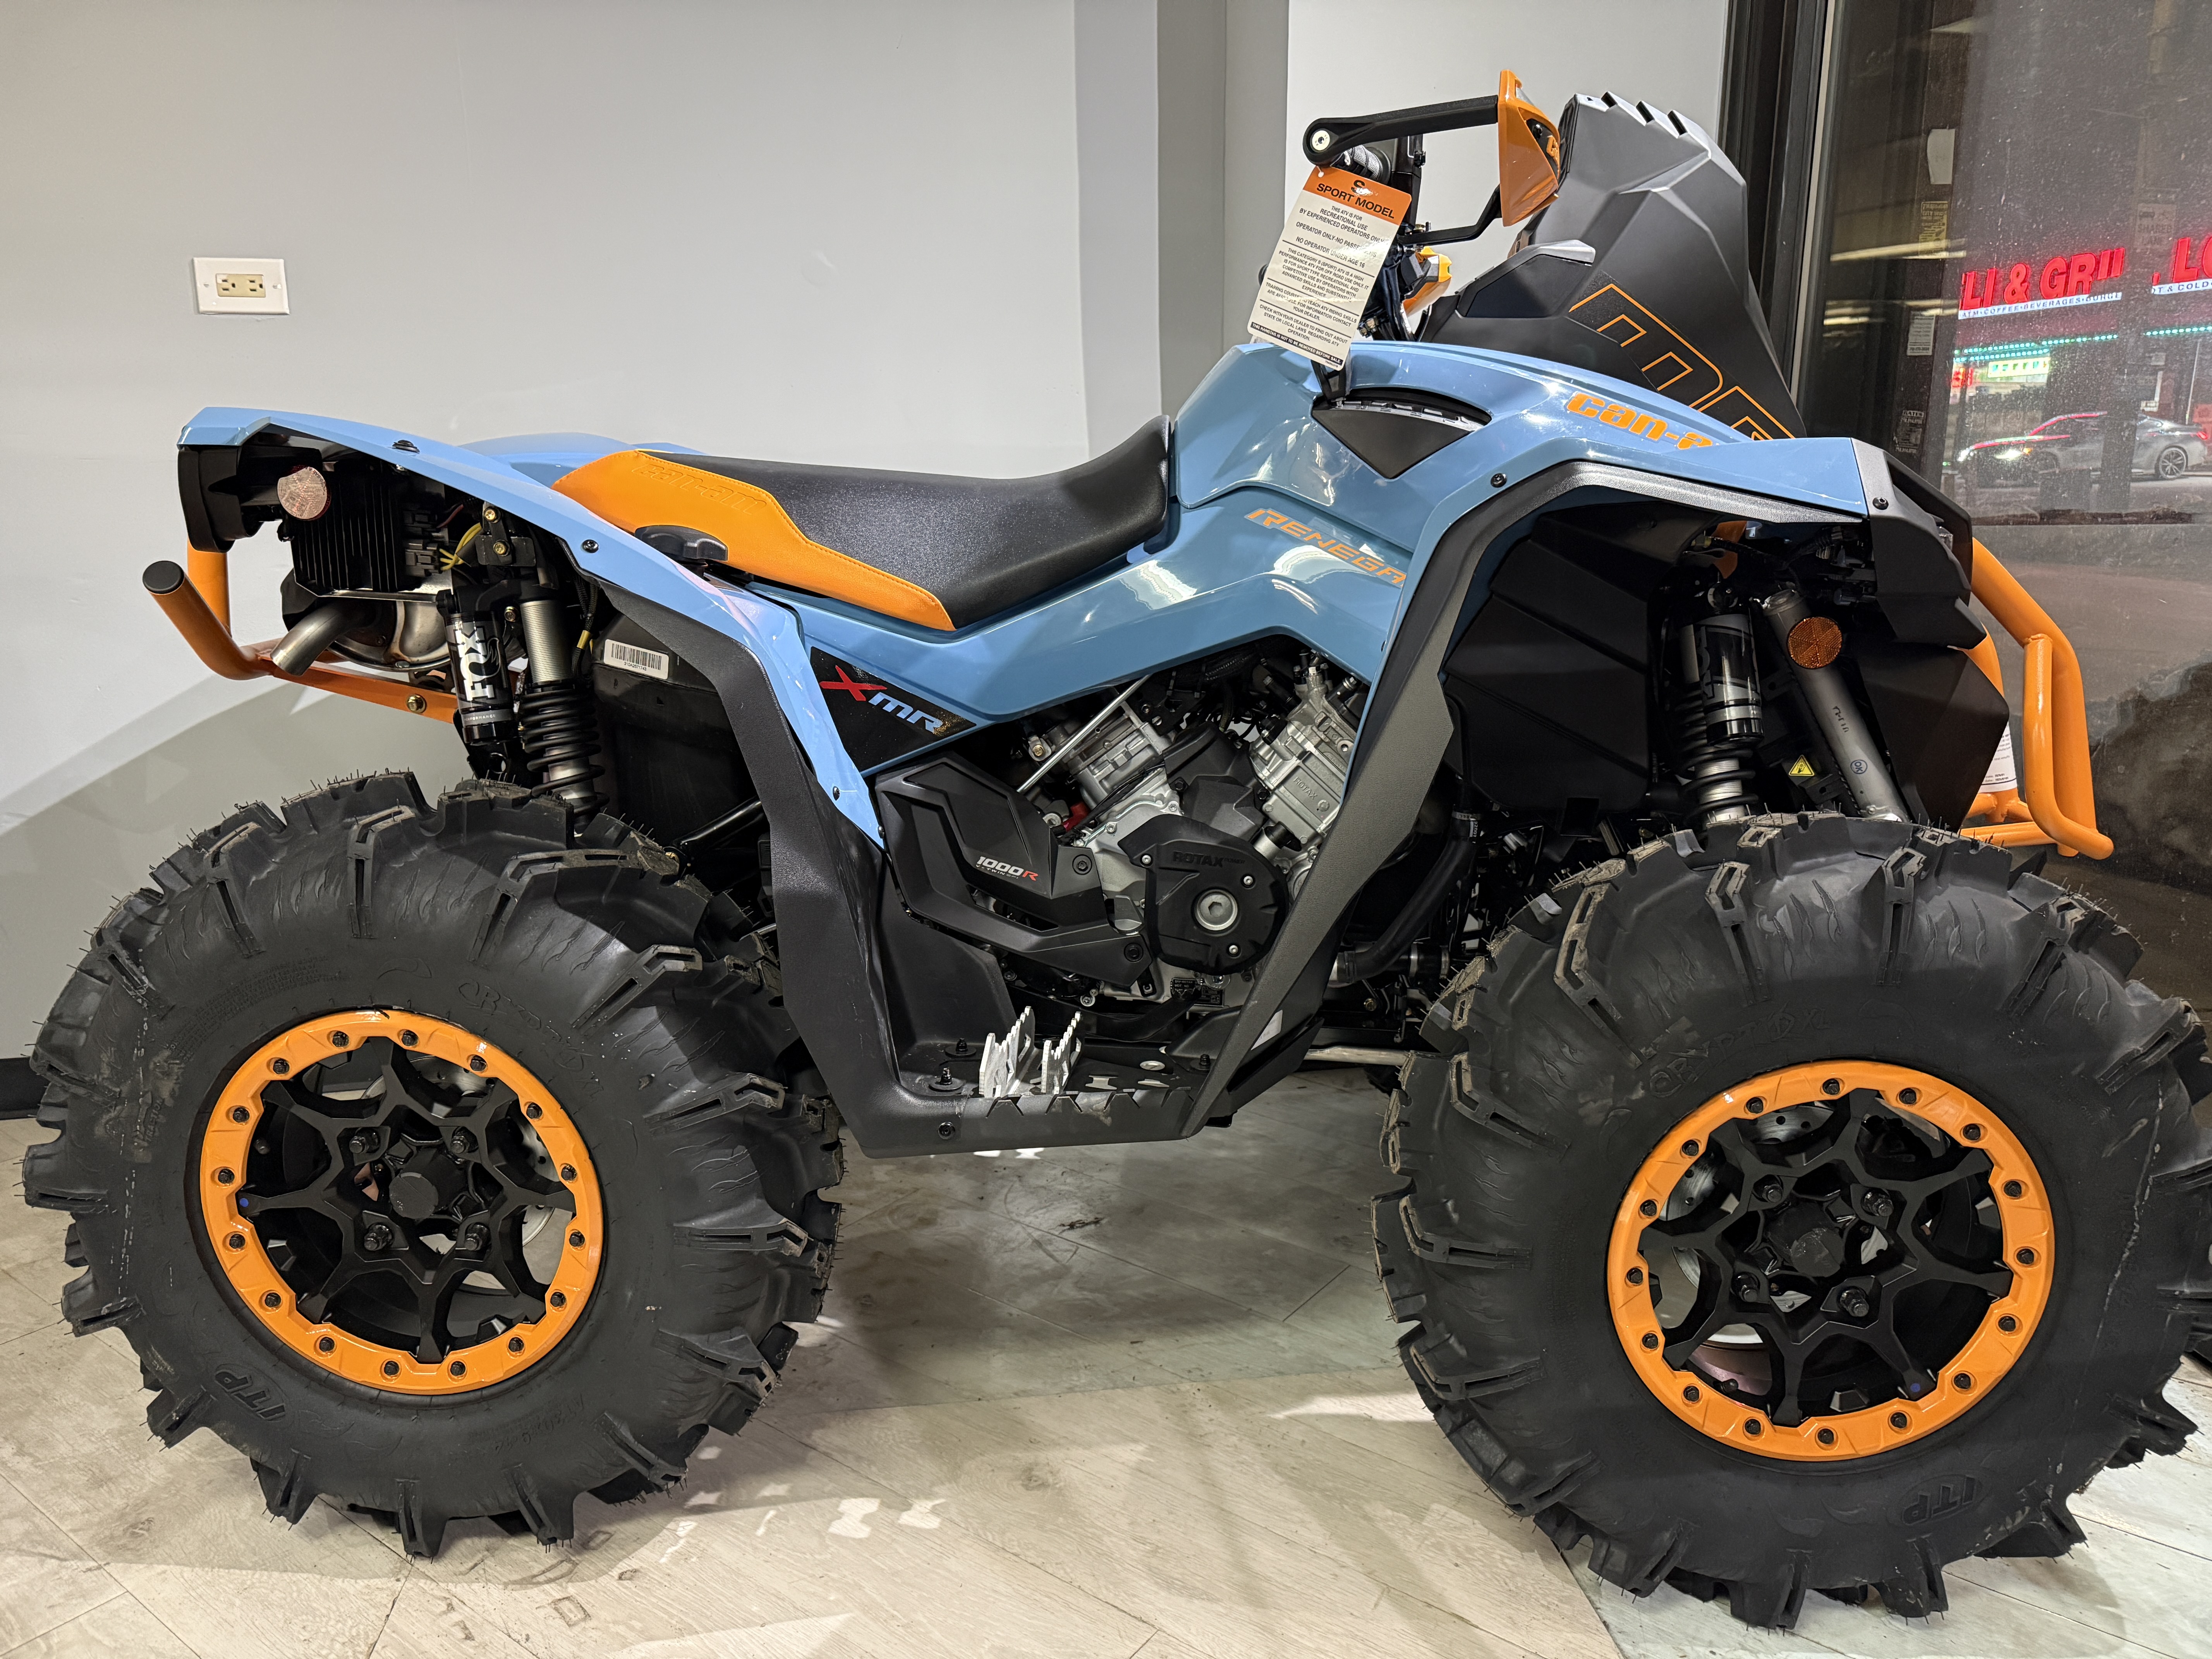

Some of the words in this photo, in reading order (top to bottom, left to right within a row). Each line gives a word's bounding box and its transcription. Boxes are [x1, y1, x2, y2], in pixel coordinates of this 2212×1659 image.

[1317, 183, 1354, 201] SPORT
[1355, 197, 1394, 218] MODEL
[1296, 222, 1322, 235] OPERATOR
[1307, 211, 1340, 227] EXPERIENCED
[1340, 224, 1370, 239] OPERATORS
[1320, 208, 1355, 226] RECREATIONAL
[1357, 222, 1368, 230] USE
[1279, 251, 1307, 265] PERFORMANCE
[1297, 251, 1317, 263] CATEGORY
[1321, 261, 1337, 271] (SPORT)
[1304, 240, 1329, 253] OPERATOR
[1331, 251, 1346, 260] UNDER
[1282, 264, 1307, 277] COMPETITIVE
[1322, 281, 1345, 293] OPERATORS
[1282, 270, 1302, 282] ADVANCED
[1302, 279, 1316, 287] SKILLS
[1320, 273, 1349, 289] RECREATIONAL
[2003, 263, 2030, 305] &
[1266, 282, 1283, 292] TRAINING
[1329, 308, 1342, 317] RIDING
[1343, 314, 1357, 323] SKILLS
[1259, 304, 1273, 313] CHECK
[1293, 318, 1309, 328] DEALER
[1333, 335, 1348, 343] ABOUT
[1306, 305, 1332, 319] INFORMATION
[1333, 316, 1351, 326] CONTACT
[1282, 319, 1294, 328] LOCAL
[1307, 330, 1331, 343] REGARDING
[1298, 343, 1316, 352] REMOVED
[1316, 350, 1330, 359] BEFORE
[455, 627, 501, 701] FOX
[464, 714, 496, 722] PERFORMANCE
[1293, 776, 1317, 800] ROTAX
[975, 864, 1005, 876] V-TWIN
[976, 856, 1039, 881] 1000R
[1173, 851, 1223, 868] ROTAX
[215, 1369, 287, 1422] ITP
[1901, 1474, 1977, 1525] ITP
